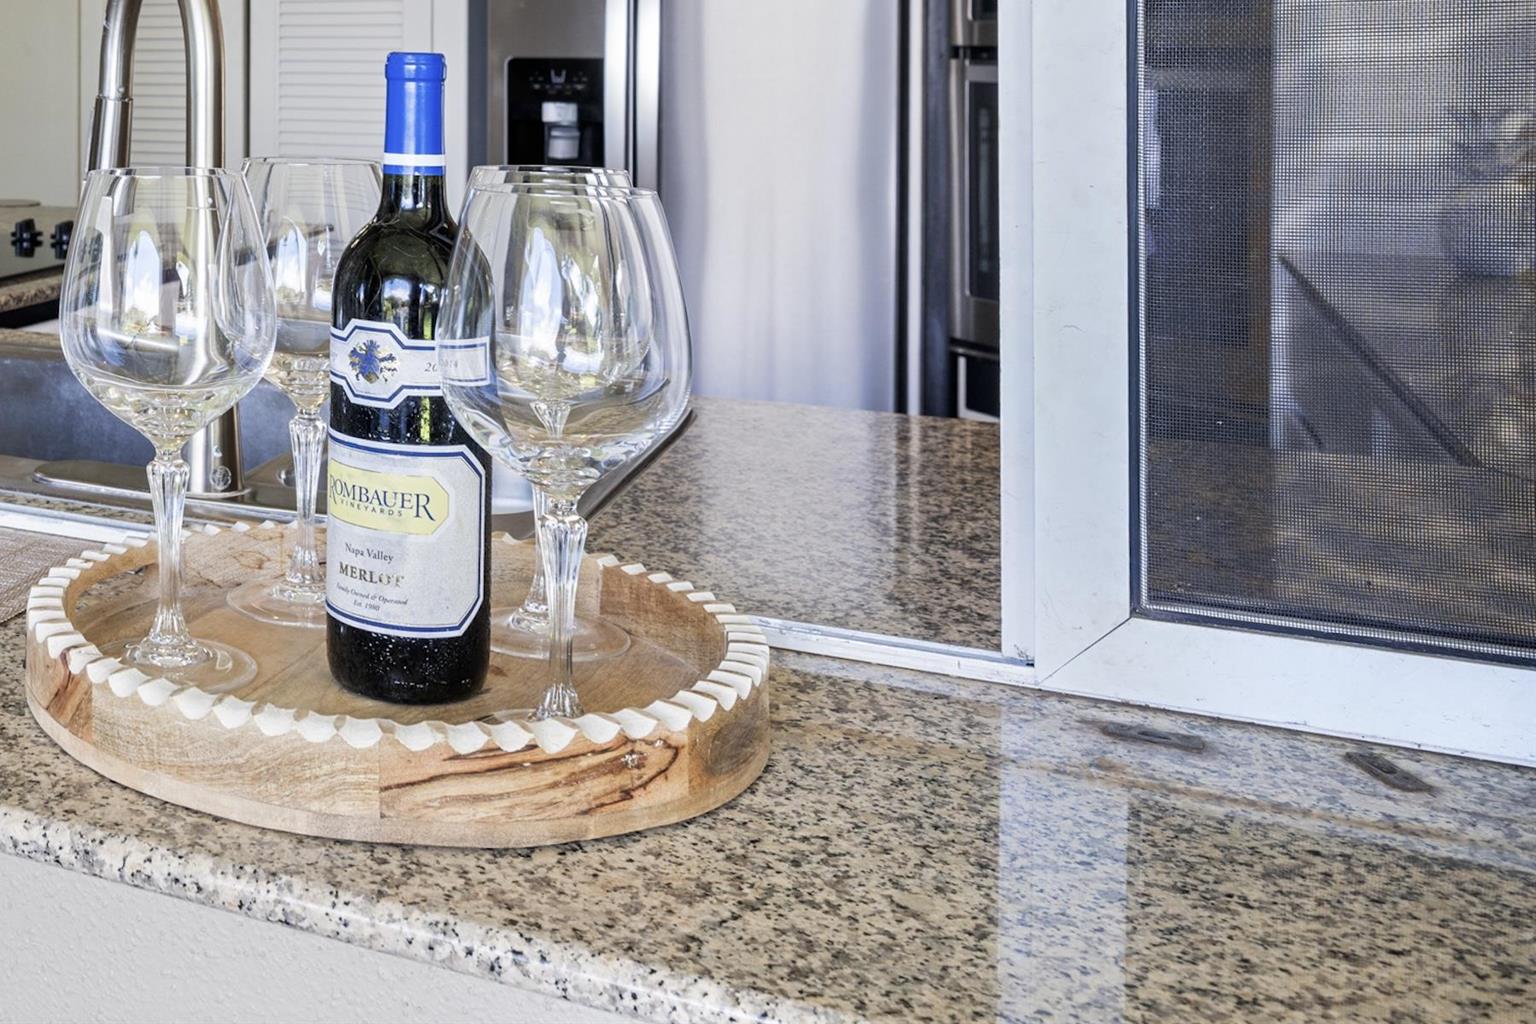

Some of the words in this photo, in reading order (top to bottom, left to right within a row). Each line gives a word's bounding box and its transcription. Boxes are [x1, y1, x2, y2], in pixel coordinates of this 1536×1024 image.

[329, 474, 435, 521] ROMBAUER
[340, 498, 402, 517] VINEYARDS
[345, 542, 365, 558] Napa
[366, 547, 394, 564] Valley
[339, 561, 405, 588] MERLOT
